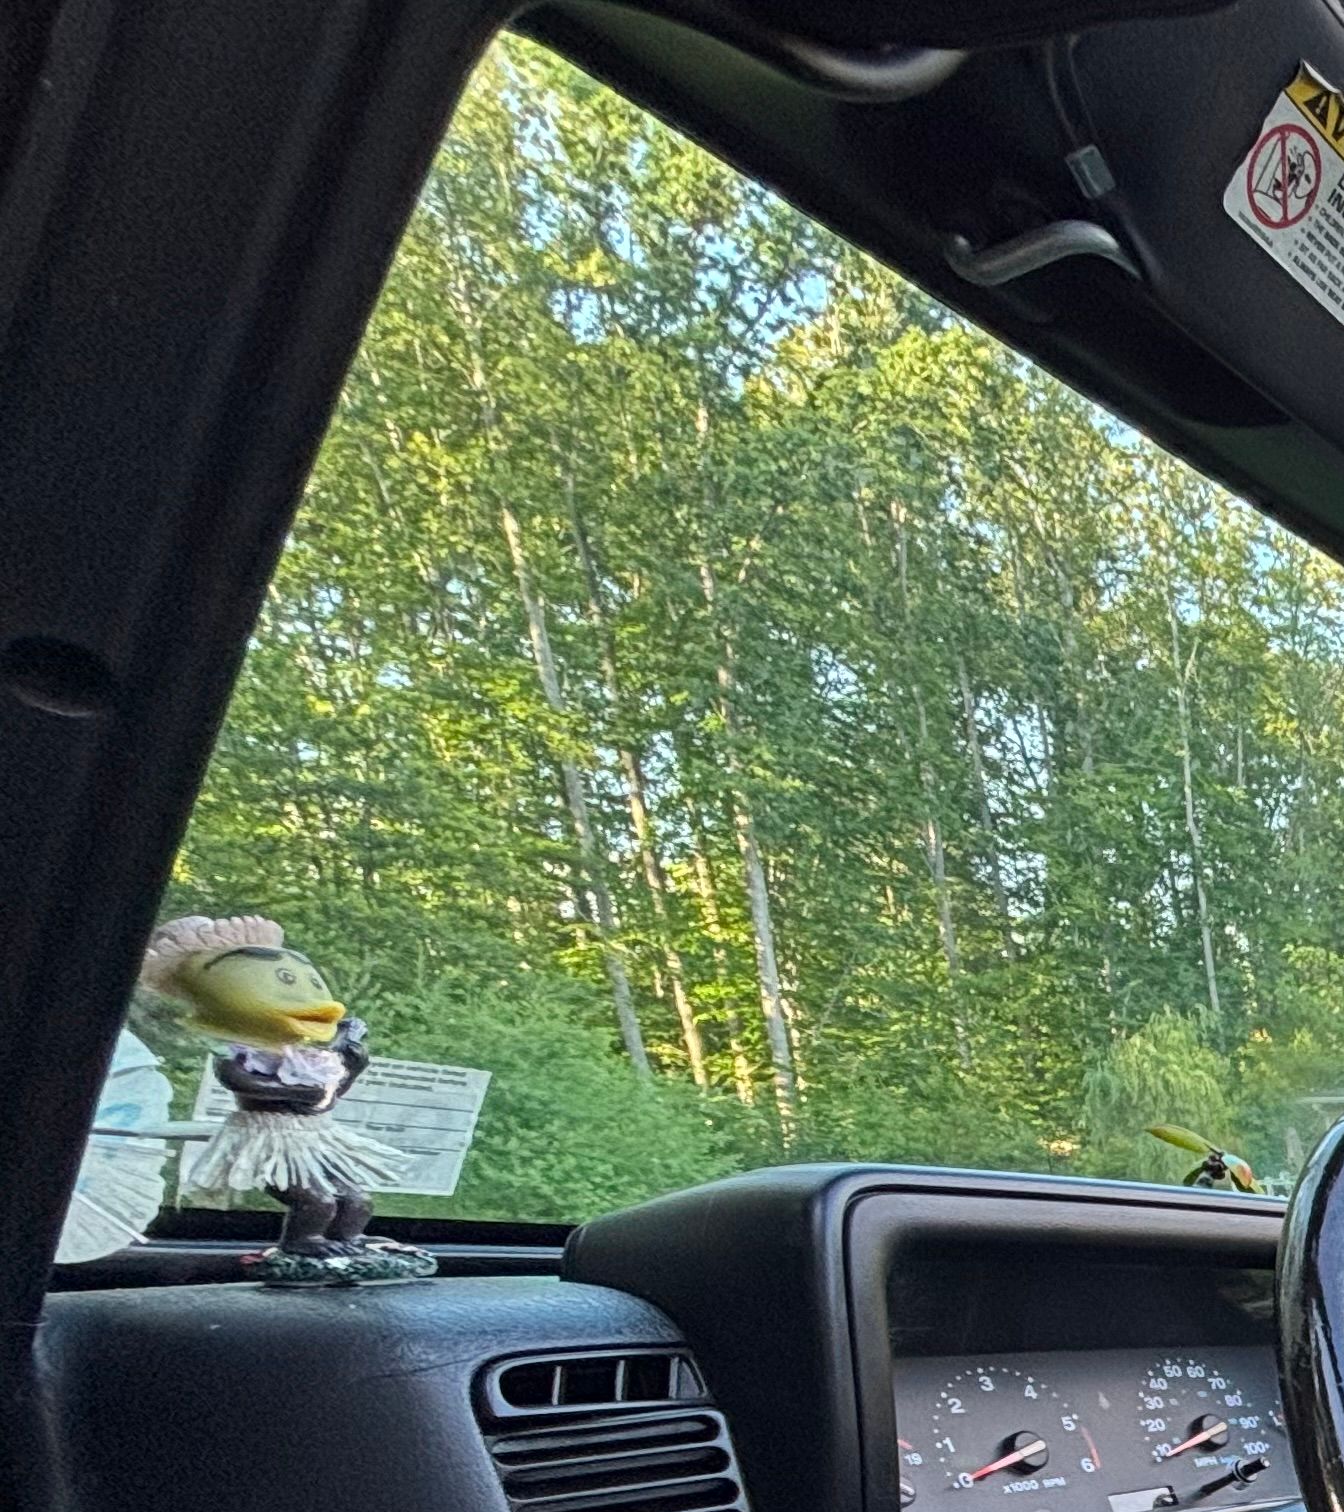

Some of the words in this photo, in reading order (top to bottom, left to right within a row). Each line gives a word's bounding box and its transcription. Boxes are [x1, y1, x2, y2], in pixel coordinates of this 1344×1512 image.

[1163, 1365, 1182, 1378] 50
[1187, 1365, 1205, 1378] 60
[978, 1375, 995, 1392] 3
[1149, 1377, 1168, 1390] 40
[1207, 1377, 1226, 1390] 70
[1024, 1384, 1038, 1400] 4
[947, 1398, 966, 1414] 2
[1144, 1396, 1164, 1410] 30
[1061, 1416, 1076, 1431] 5
[1147, 1418, 1165, 1432] 20
[1239, 1416, 1257, 1429] 90
[943, 1437, 955, 1453] 1
[1243, 1441, 1266, 1455] 100
[1080, 1458, 1096, 1473] 6
